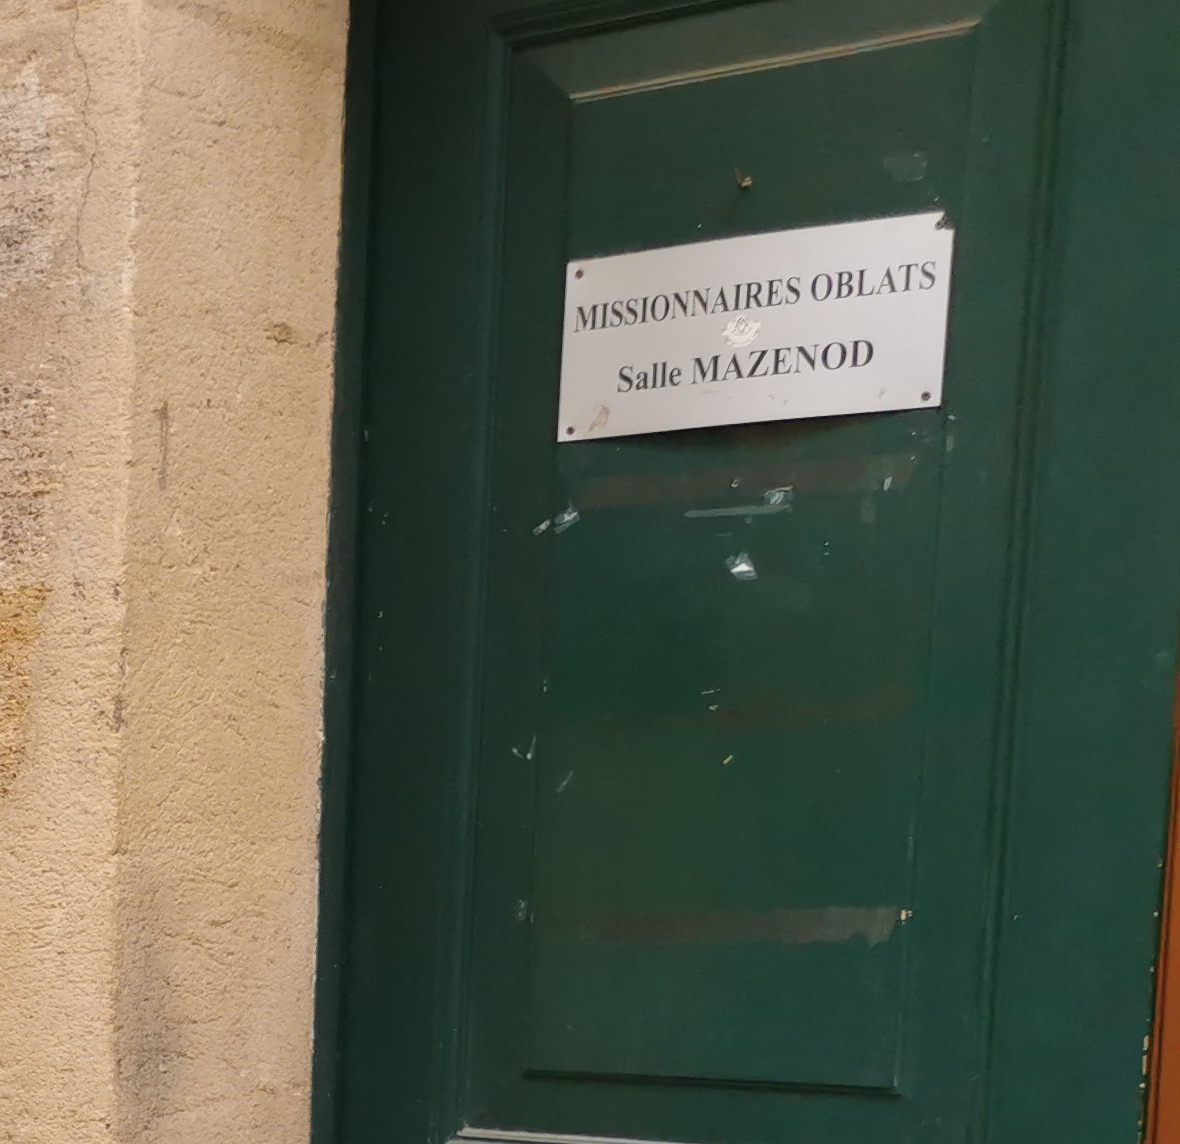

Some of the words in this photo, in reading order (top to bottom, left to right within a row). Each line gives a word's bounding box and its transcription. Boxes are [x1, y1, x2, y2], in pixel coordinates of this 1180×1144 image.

[575, 277, 800, 332] MISSIONNAIRES
[811, 262, 935, 301] OBLATS
[618, 362, 681, 392] Salle
[692, 340, 873, 384] MAZENOD
